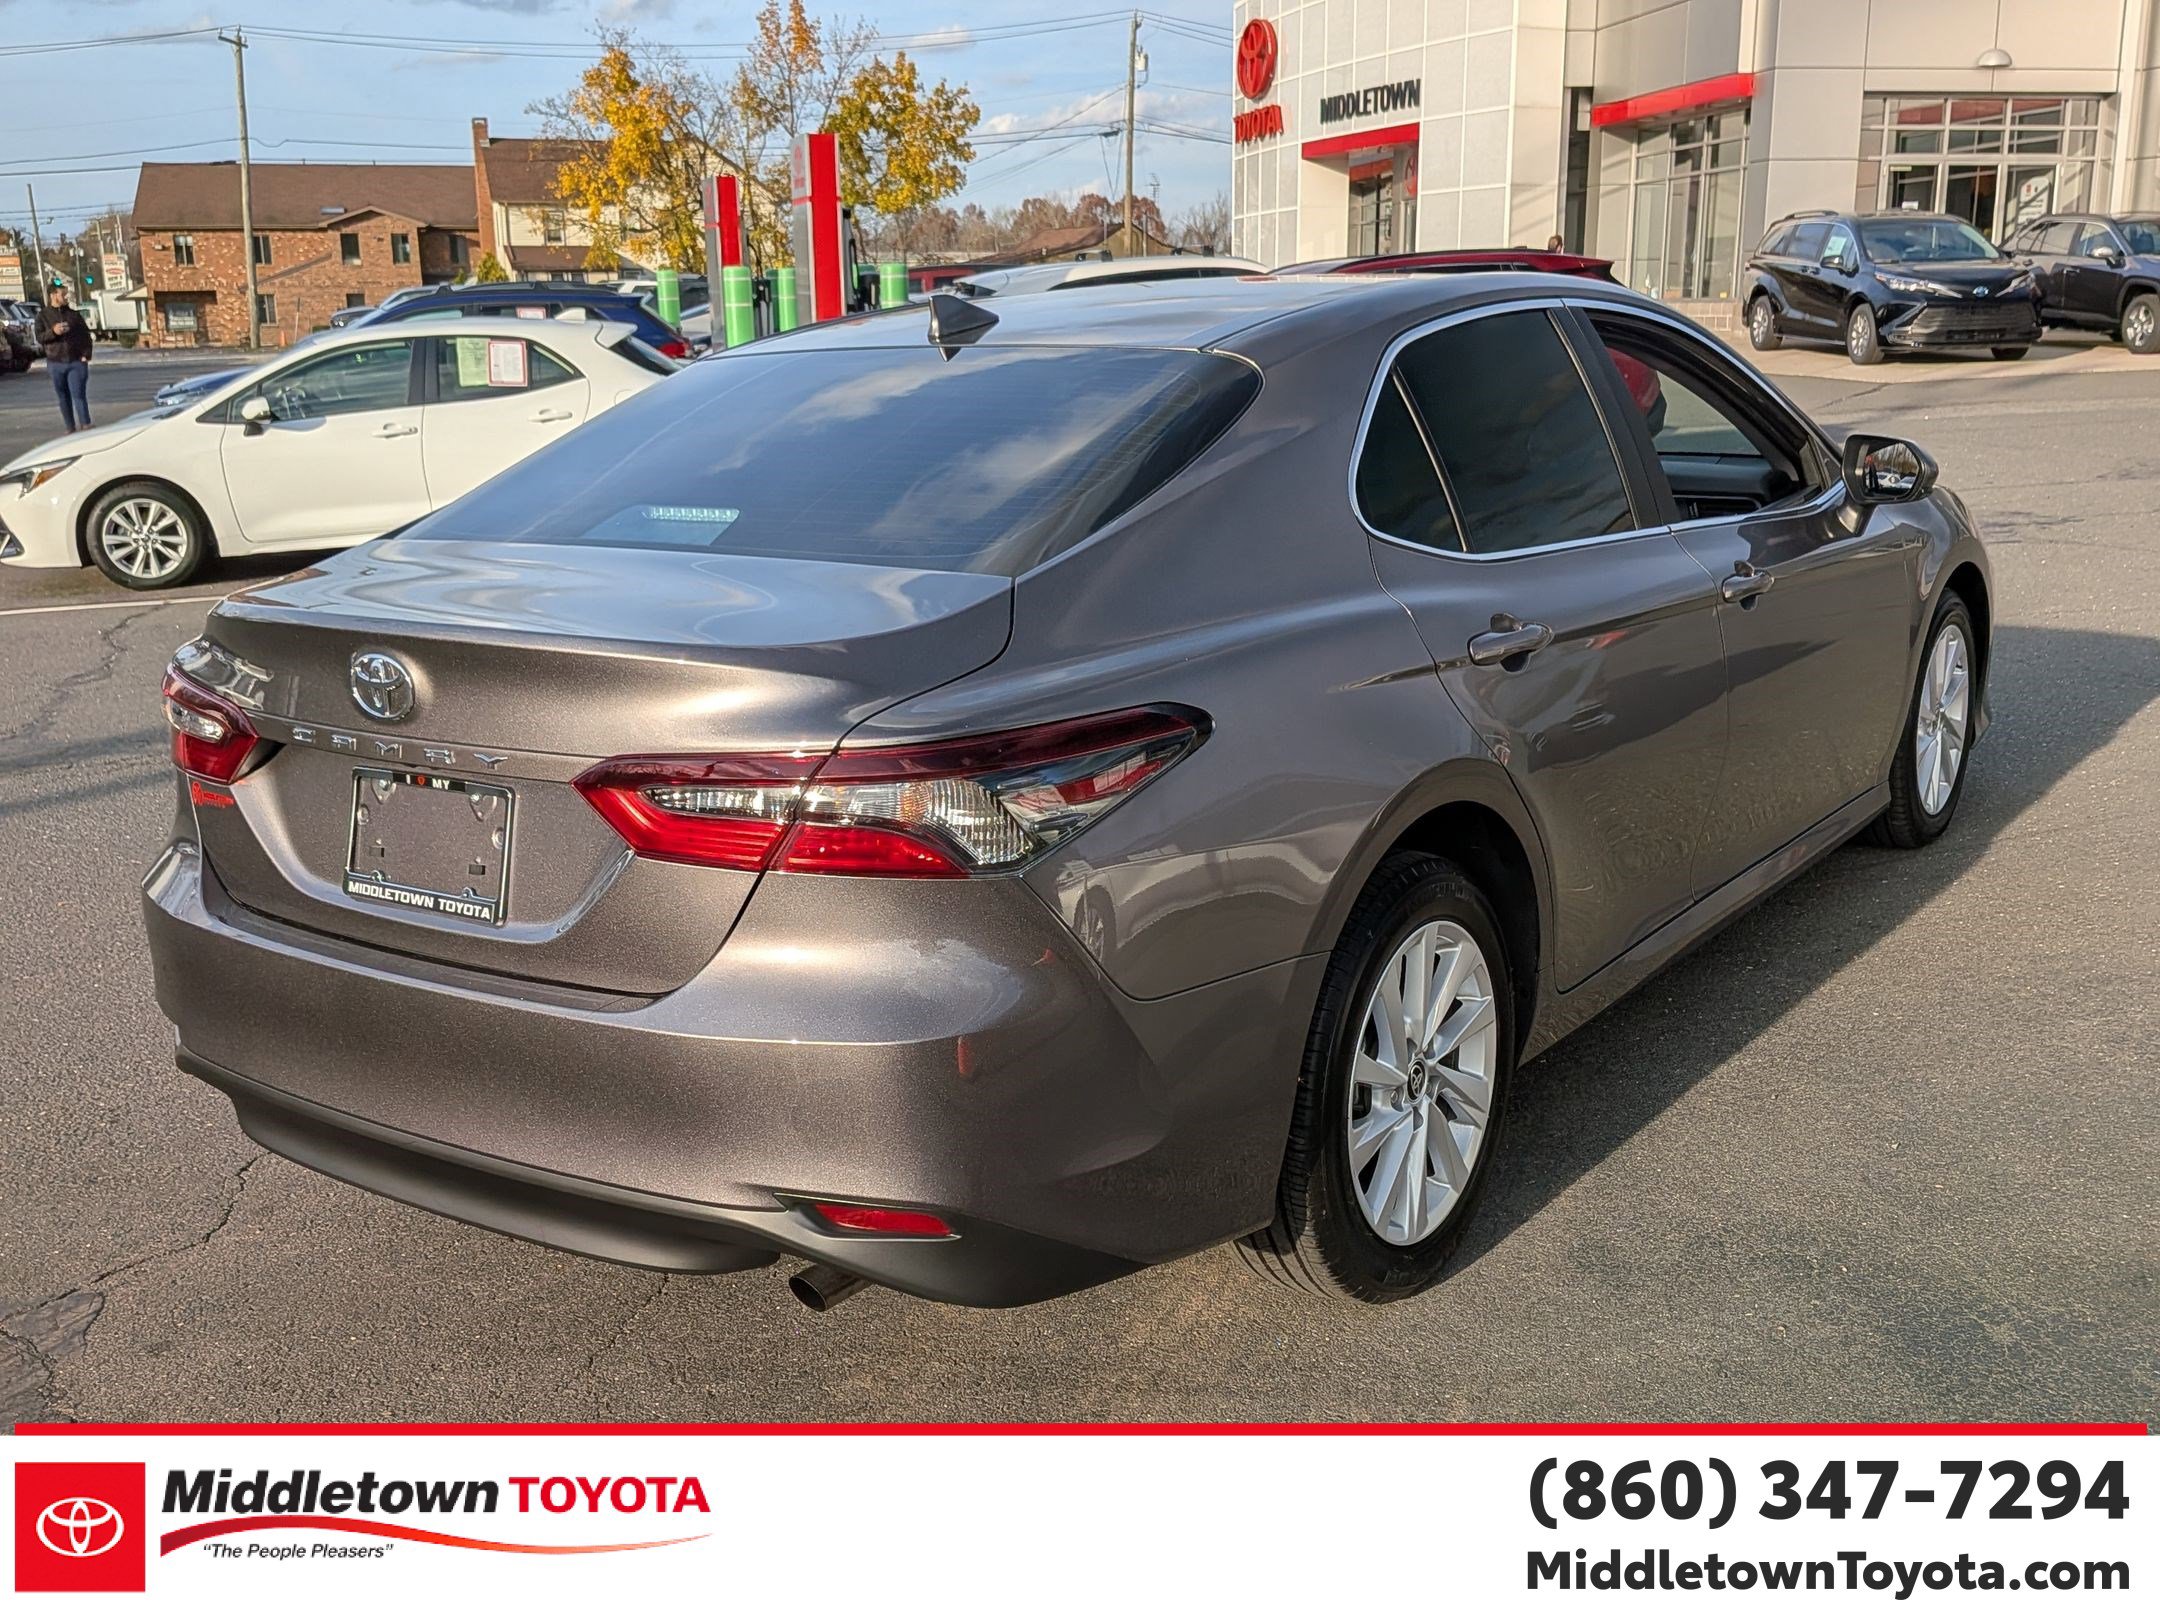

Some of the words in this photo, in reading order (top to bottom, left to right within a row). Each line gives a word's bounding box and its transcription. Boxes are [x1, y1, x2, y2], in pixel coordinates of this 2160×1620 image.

[1320, 79, 1421, 124] MIDDLETOWN
[1233, 105, 1284, 144] TOYOTA
[293, 727, 508, 770] CAMRY
[432, 778, 450, 790] MY
[348, 881, 434, 908] MIDDLETOWN
[438, 898, 491, 919] TOYOTA
